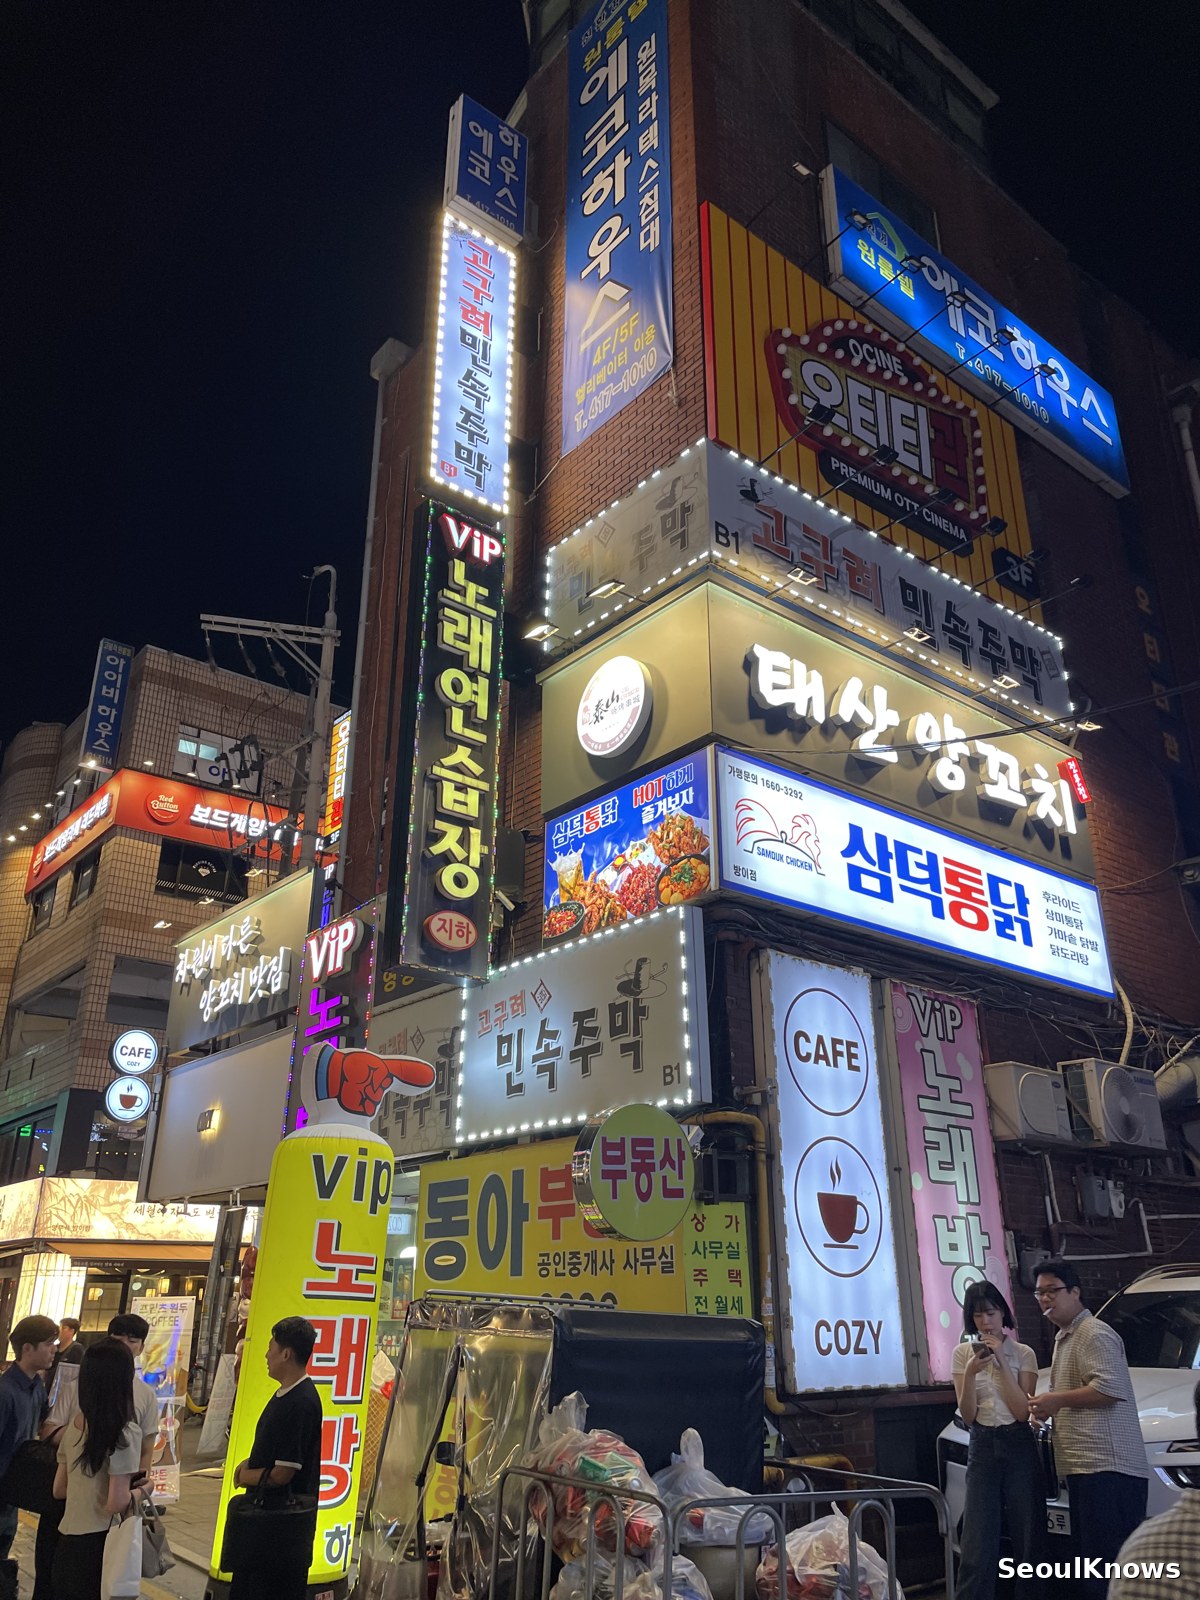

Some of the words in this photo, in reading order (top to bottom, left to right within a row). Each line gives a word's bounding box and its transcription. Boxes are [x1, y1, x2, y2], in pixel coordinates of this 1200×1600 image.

[467, 120, 494, 186] 에코
[495, 124, 522, 218] 하우스
[578, 38, 633, 356] 에코하우스
[575, 346, 628, 406] 엘리베이터
[633, 323, 656, 352] 이용
[592, 311, 640, 367] 4F/5F
[848, 338, 906, 378] OCINE
[917, 255, 1114, 447] 에코하우스
[453, 326, 495, 494] 민속주막
[442, 462, 456, 478] B1
[831, 456, 892, 501] PREMIUM
[894, 494, 920, 516] OTT
[922, 508, 968, 542] CINEMA
[714, 520, 740, 555] B1
[752, 503, 886, 615] 고구려
[1005, 555, 1034, 588] 3F
[898, 575, 1044, 706] 민속주막
[430, 558, 498, 900] 노래연습장
[751, 643, 1078, 836] 태산양꼬치
[150, 800, 180, 813] Button
[158, 794, 174, 804] Red
[641, 786, 695, 825] 즐겨보자
[727, 764, 758, 785] 가맹문의
[761, 777, 804, 801] 1660-3292
[551, 796, 619, 850] 삼덕통닭
[733, 864, 757, 882] 방이점
[756, 846, 785, 864] SAMDUK
[785, 855, 813, 873] CHICKEN
[840, 822, 1034, 949] 삼덕통닭
[1042, 890, 1082, 914] 후라이드
[175, 934, 218, 983] 차원이
[221, 915, 258, 960] 다른
[436, 918, 473, 946] 지하
[1049, 943, 1090, 966] 닭도리탕
[1079, 936, 1100, 953] 닭발
[199, 966, 245, 1022] 양꼬치
[248, 946, 286, 1003] 맛집
[477, 988, 527, 1037] 고구려
[119, 1044, 153, 1060] CAFE
[495, 998, 650, 1099] 민속주막
[662, 1061, 682, 1088] B1
[793, 1030, 862, 1073] CAFE
[312, 1147, 392, 1216] vip
[599, 1136, 686, 1203] 부동산
[917, 1048, 991, 1309] 노래방
[424, 1168, 530, 1281] 동아
[690, 1240, 741, 1261] 사무실
[537, 1250, 615, 1279] 공인중개사
[622, 1244, 676, 1277] 사무실
[303, 1219, 377, 1508] 노래방
[813, 1318, 884, 1356] COZY
